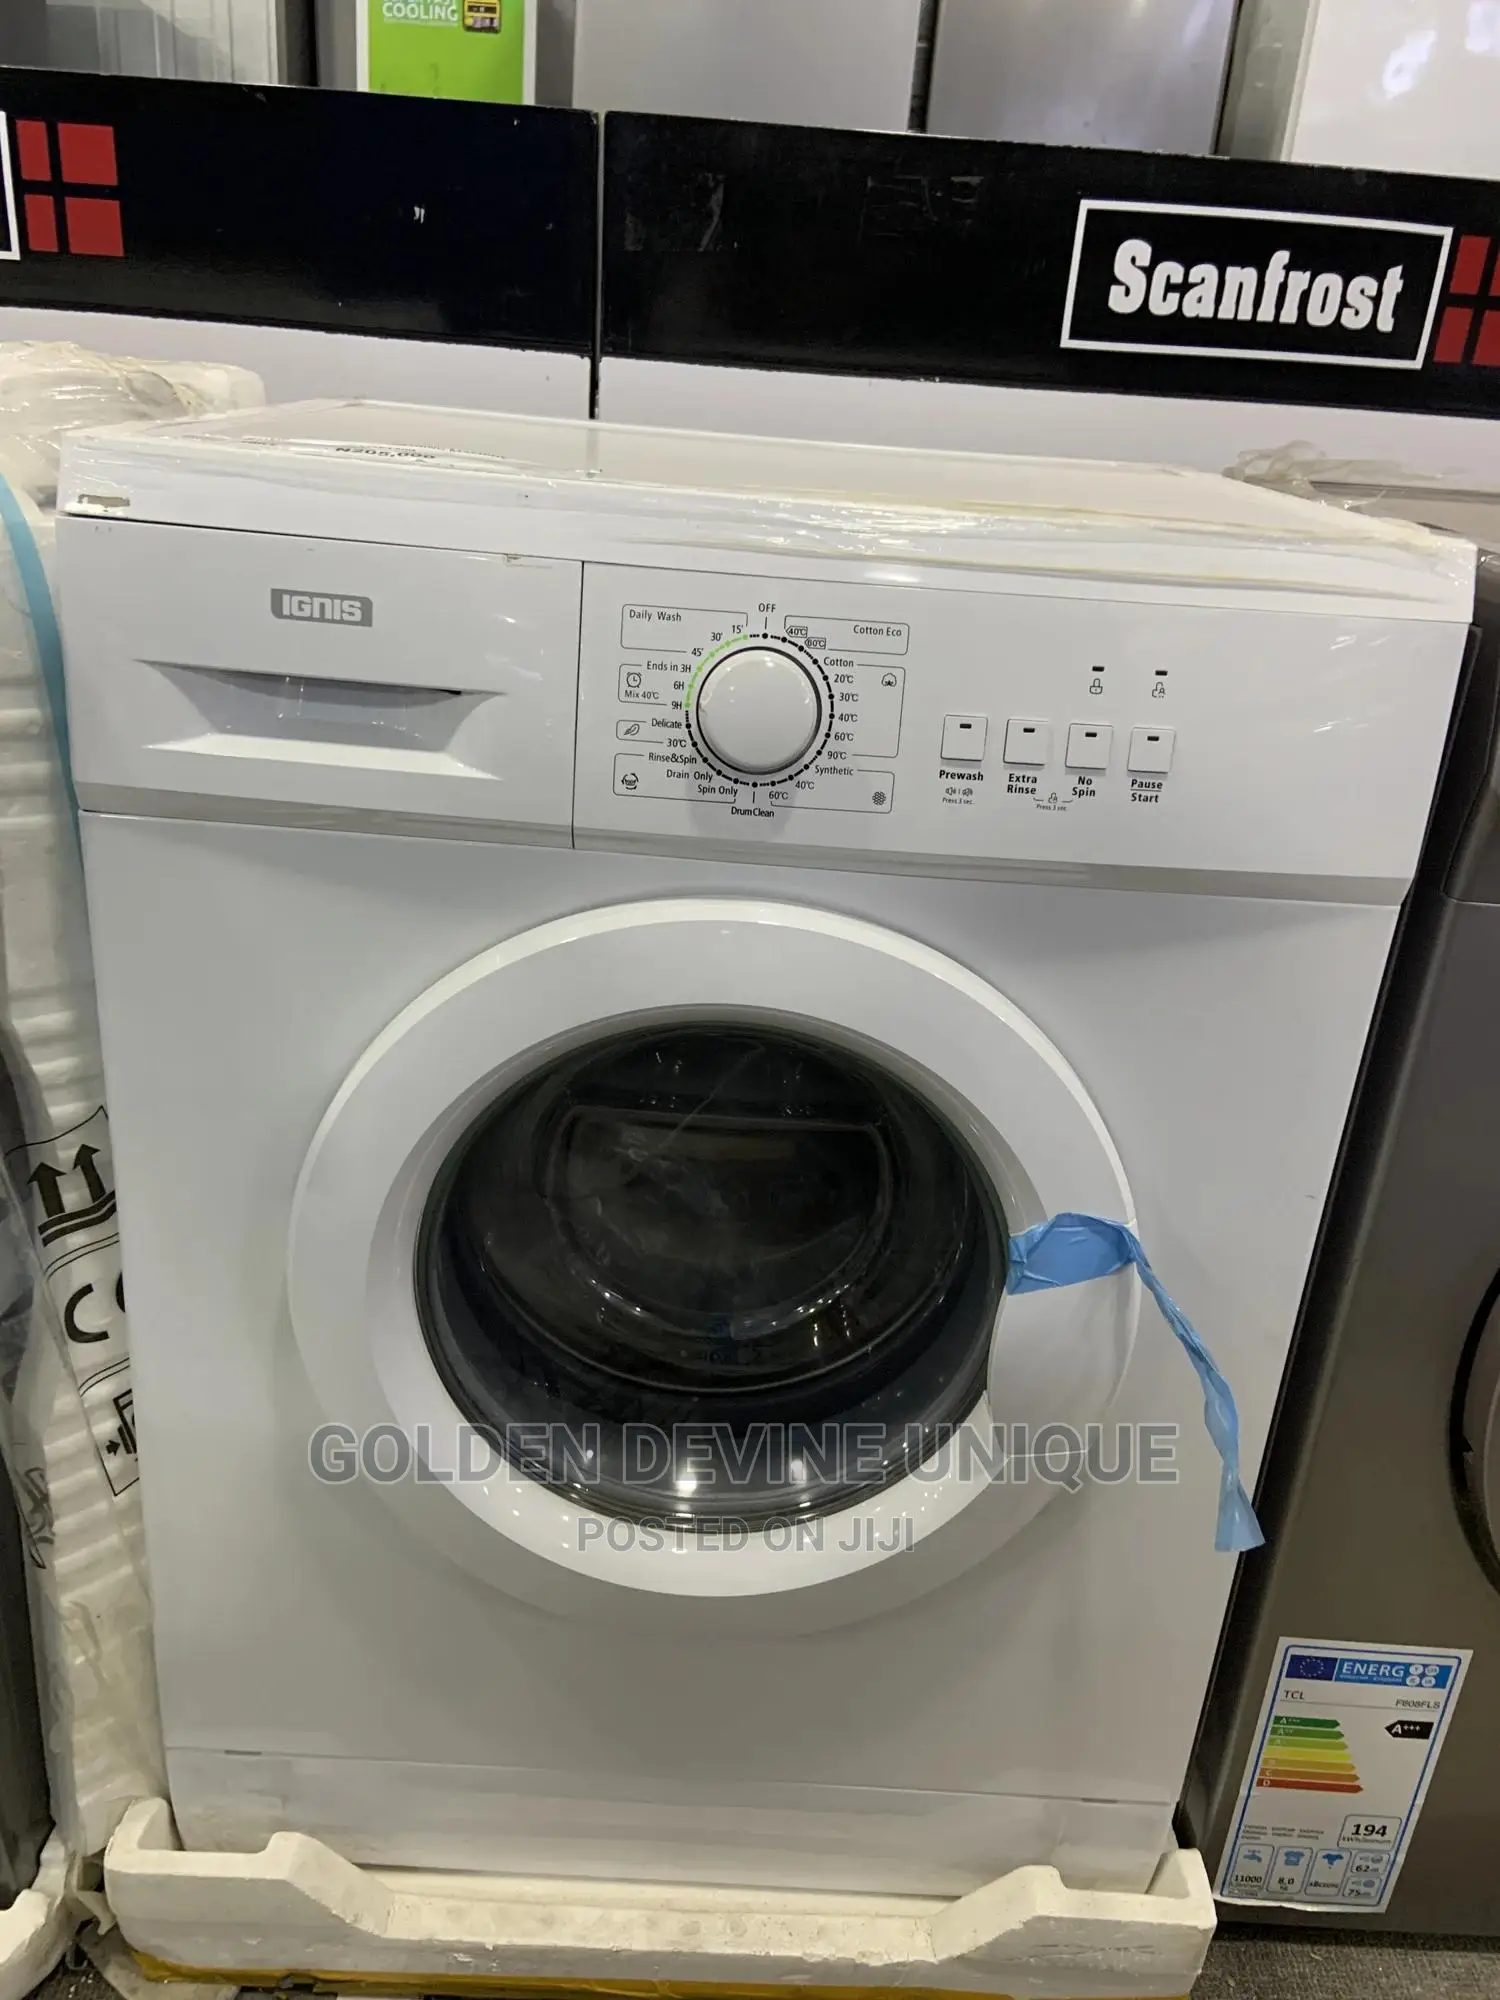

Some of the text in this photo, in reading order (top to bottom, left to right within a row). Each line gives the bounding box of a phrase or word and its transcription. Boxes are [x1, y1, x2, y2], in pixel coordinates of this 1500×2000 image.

[382, 3, 458, 21] COOLING
[1108, 238, 1404, 333] Scanfrost
[282, 593, 362, 622] IGNIS
[758, 603, 776, 613] OFF
[629, 609, 681, 622] Daily Wash
[853, 625, 902, 637] Cotton Eco
[647, 661, 691, 673] Ends in 3H
[823, 657, 853, 667] Cotton
[673, 681, 684, 690] 6H
[624, 690, 640, 699] Mix
[671, 701, 682, 710] 9H
[652, 719, 682, 729] Delicate
[649, 753, 697, 765] Rinse&Spin
[666, 769, 713, 782] Drain Only
[815, 765, 854, 777] Synthetic
[939, 769, 984, 782] Prewash
[1008, 773, 1037, 784] Extra
[1078, 776, 1092, 786] No
[1007, 784, 1036, 795] Rinse
[1131, 779, 1163, 790] Pause
[697, 785, 738, 797] Spin Only
[1072, 786, 1096, 797] Spin
[1131, 792, 1158, 803] Start
[1342, 1662, 1405, 1677] ENERG
[1284, 1690, 1305, 1700] TCL
[1392, 1724, 1421, 1734] A+++
[1351, 1824, 1387, 1837] 194
[1356, 1865, 1370, 1873] 62
[1234, 1875, 1263, 1884] 11000
[1347, 1889, 1361, 1897] 75
